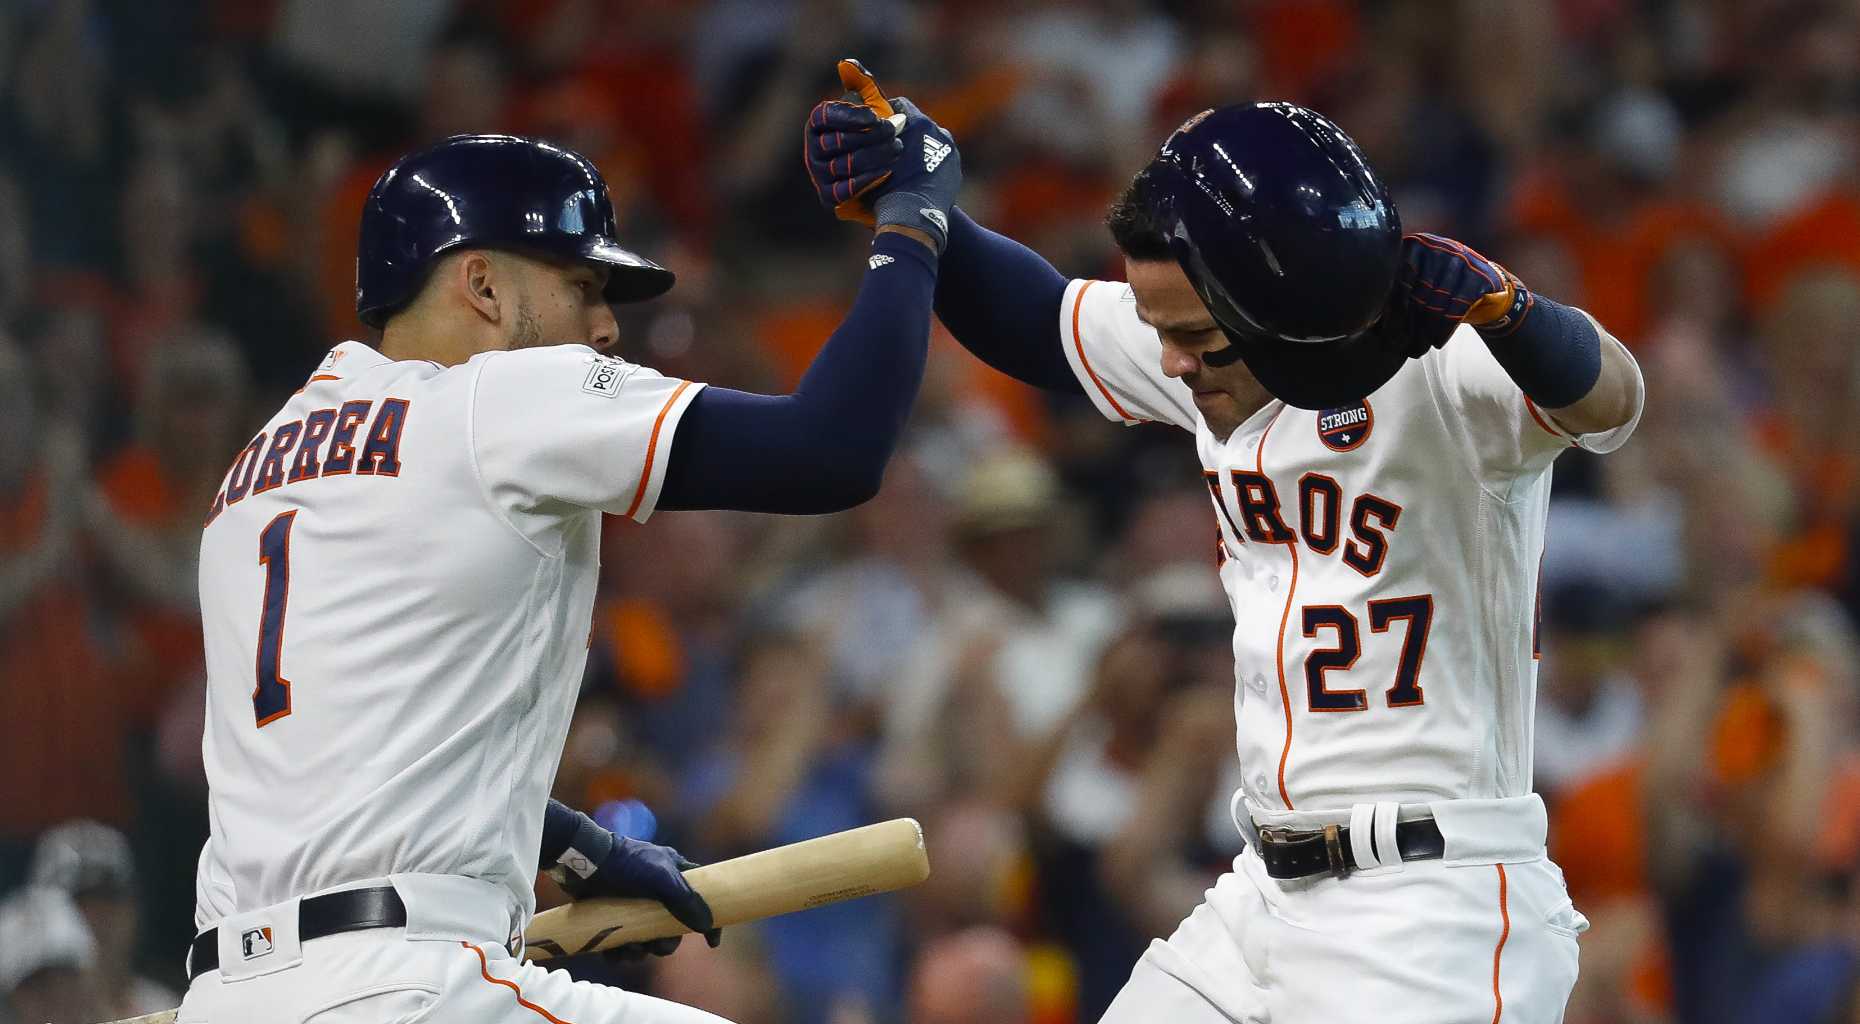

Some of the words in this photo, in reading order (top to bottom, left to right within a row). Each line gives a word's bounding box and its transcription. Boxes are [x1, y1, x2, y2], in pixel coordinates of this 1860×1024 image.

[1320, 407, 1368, 431] STRONG
[252, 508, 298, 729] 1
[1301, 593, 1434, 713] 27
